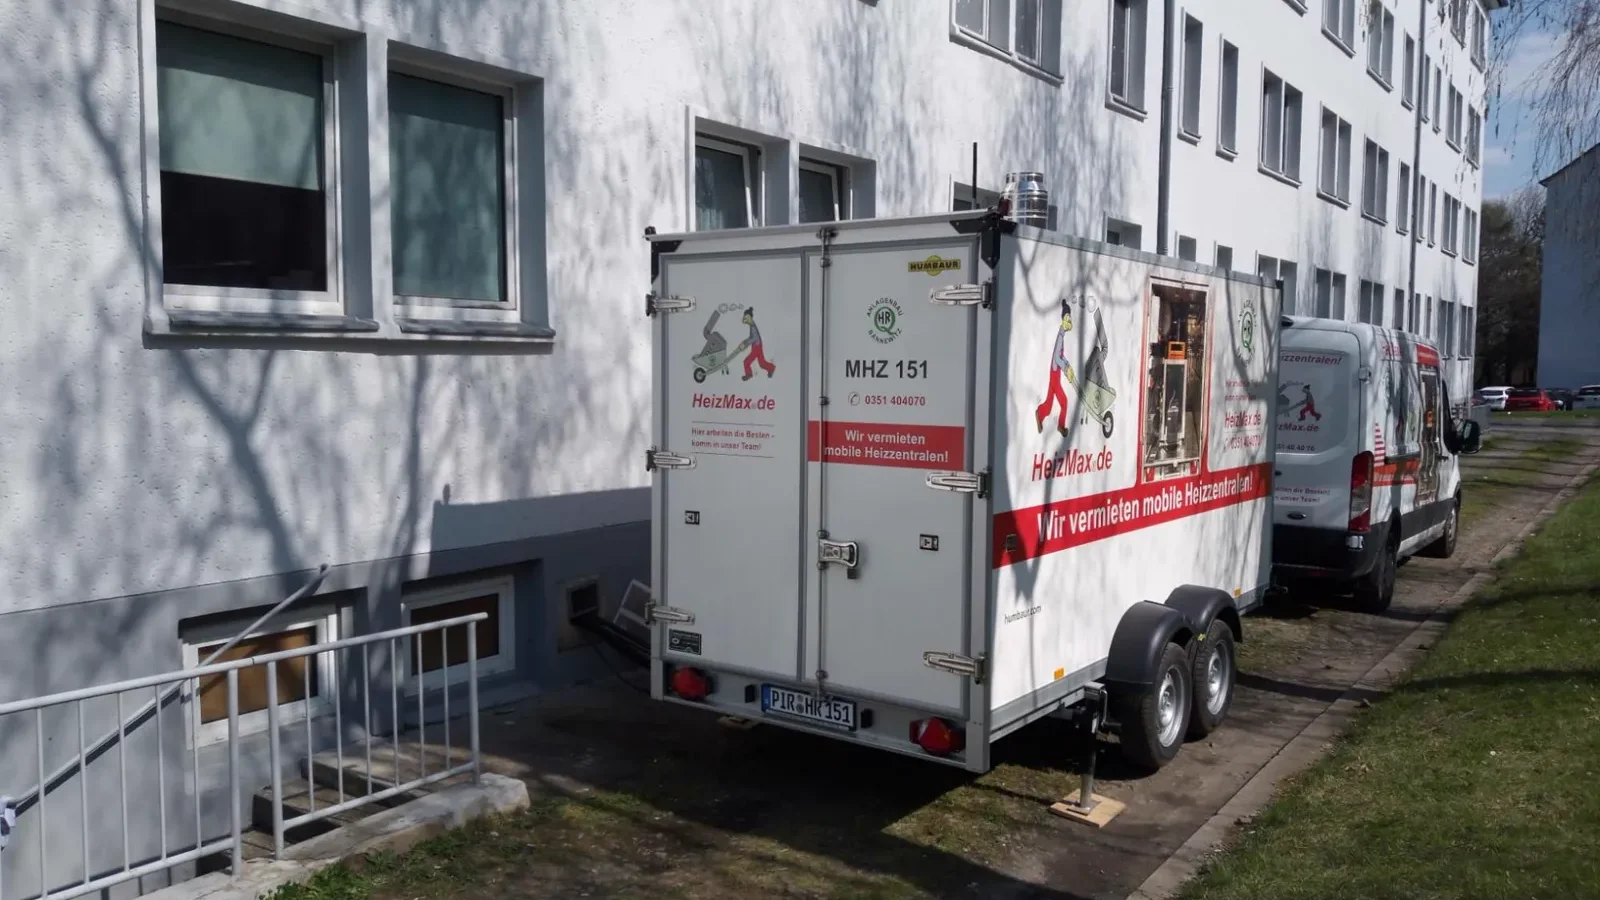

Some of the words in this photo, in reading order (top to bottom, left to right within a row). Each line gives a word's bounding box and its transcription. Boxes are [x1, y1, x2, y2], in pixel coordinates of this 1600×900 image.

[910, 261, 959, 270] HUMBAUR
[866, 297, 904, 318] ANLAGENBAU
[878, 311, 891, 325] HR
[868, 328, 902, 344] BANNEWITZ
[1281, 355, 1342, 365] izzentralen!
[845, 359, 889, 378] MHZ
[895, 359, 927, 379] 151
[692, 393, 776, 410] HeizMax.de
[864, 395, 887, 405] 0351
[890, 395, 926, 406] 404070
[692, 427, 705, 436] Hier
[706, 428, 733, 437] arbeiten
[734, 429, 745, 438] die
[746, 430, 770, 439] Besten
[1278, 422, 1320, 432] zMax.de
[692, 440, 712, 448] komm
[741, 442, 762, 450] Team!
[845, 429, 865, 442] Wir
[867, 432, 926, 445] vermieten
[824, 445, 861, 457] mobile
[864, 447, 949, 462] Heizzentralen!
[1032, 445, 1113, 482] HeizMax.de
[1037, 509, 1066, 542] Wir
[1069, 498, 1140, 534] vermieten
[1142, 487, 1182, 515] mobile
[1185, 471, 1253, 507] Heizzentralen!
[1004, 605, 1042, 624] humbaur.com
[771, 690, 795, 711] PIR
[825, 702, 850, 723] 151
